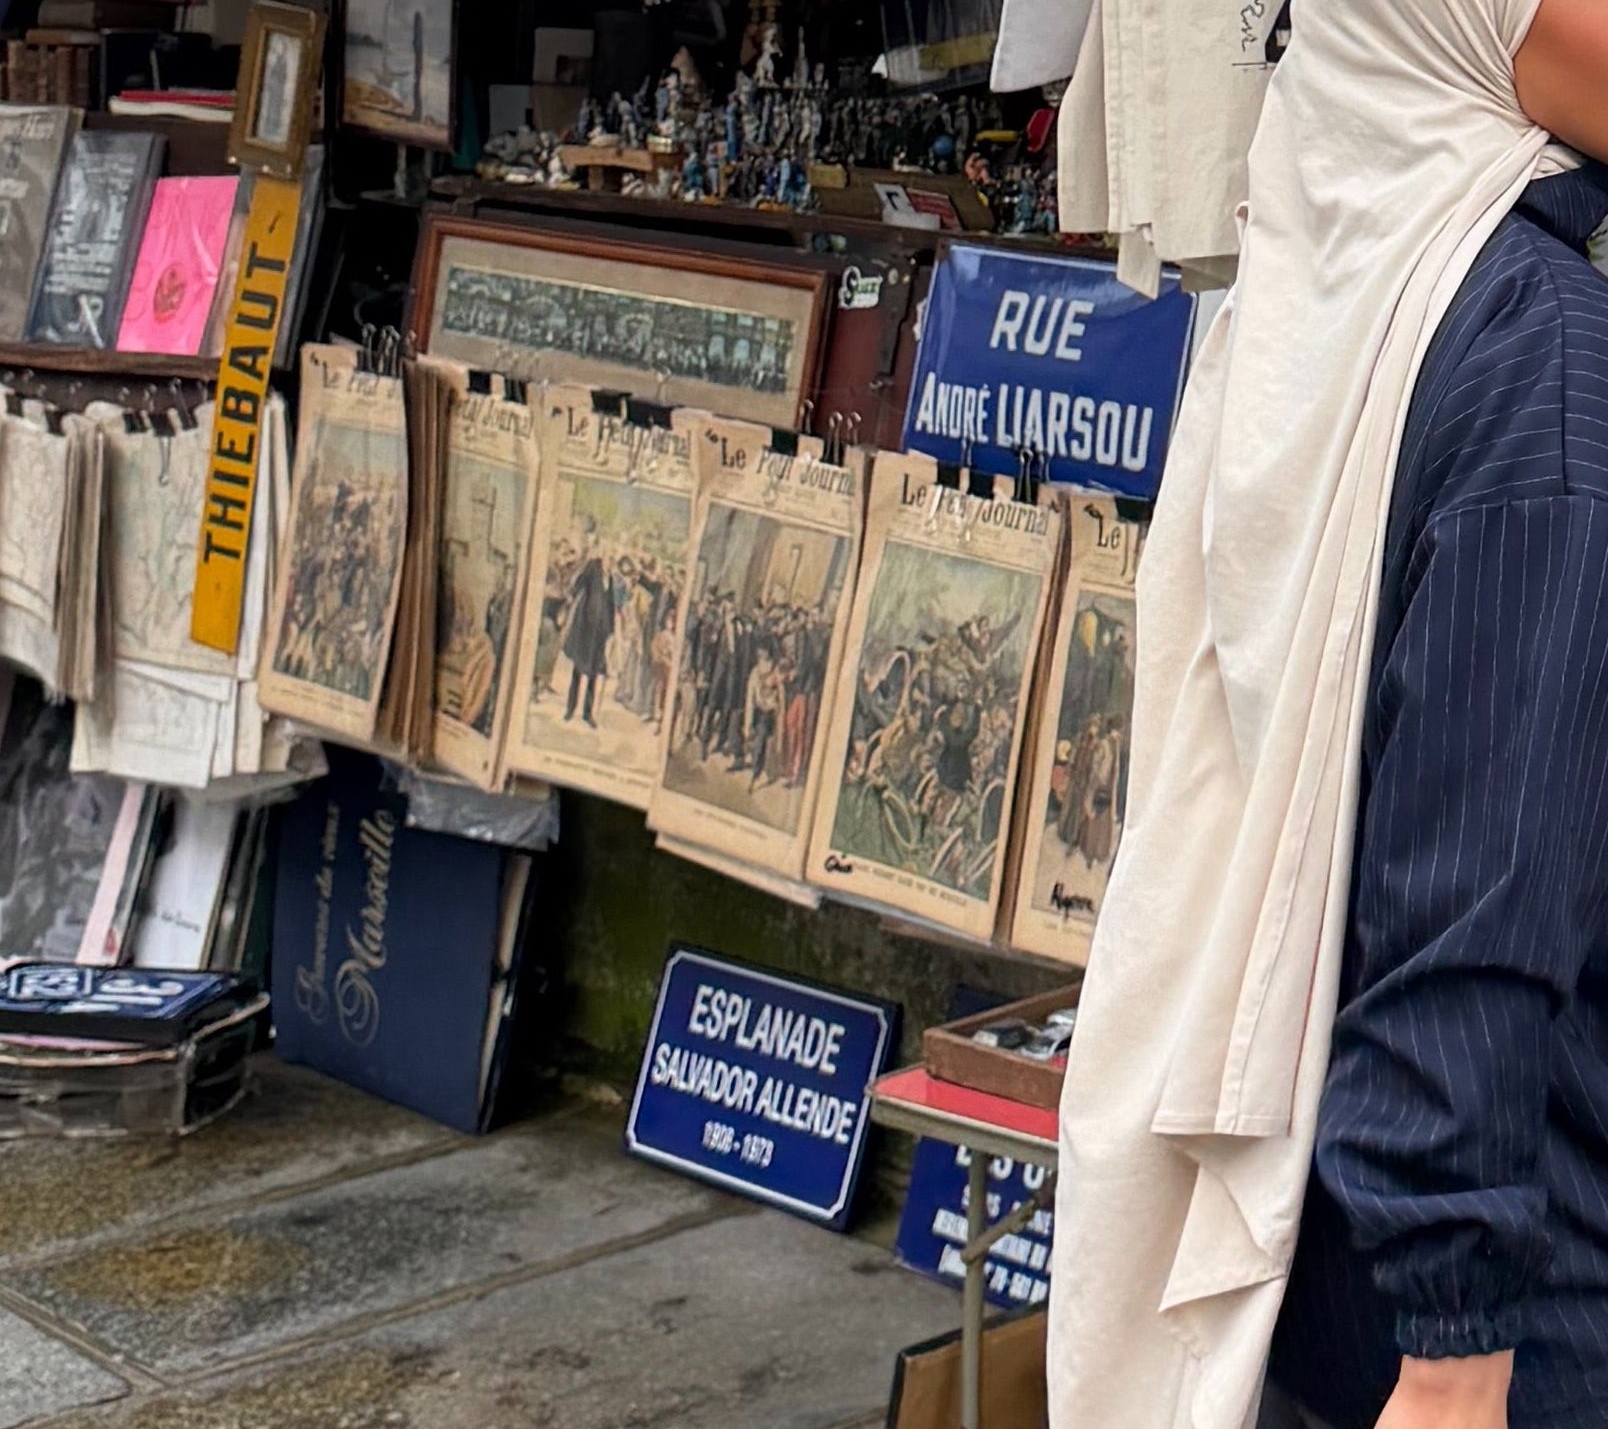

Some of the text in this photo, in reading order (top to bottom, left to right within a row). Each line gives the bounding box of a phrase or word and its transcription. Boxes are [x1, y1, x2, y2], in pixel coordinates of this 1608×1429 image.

[989, 289, 1095, 362] RUE
[202, 240, 288, 567] THIEBAUT
[567, 406, 590, 438] Le
[914, 370, 1154, 472] ANDRÉ LIARSOU
[720, 437, 747, 470] Le
[901, 472, 927, 507] Le
[1096, 512, 1122, 550] Le
[687, 982, 847, 1076] ESPLANADE
[650, 1041, 858, 1147] SALVADOR ALLENDE
